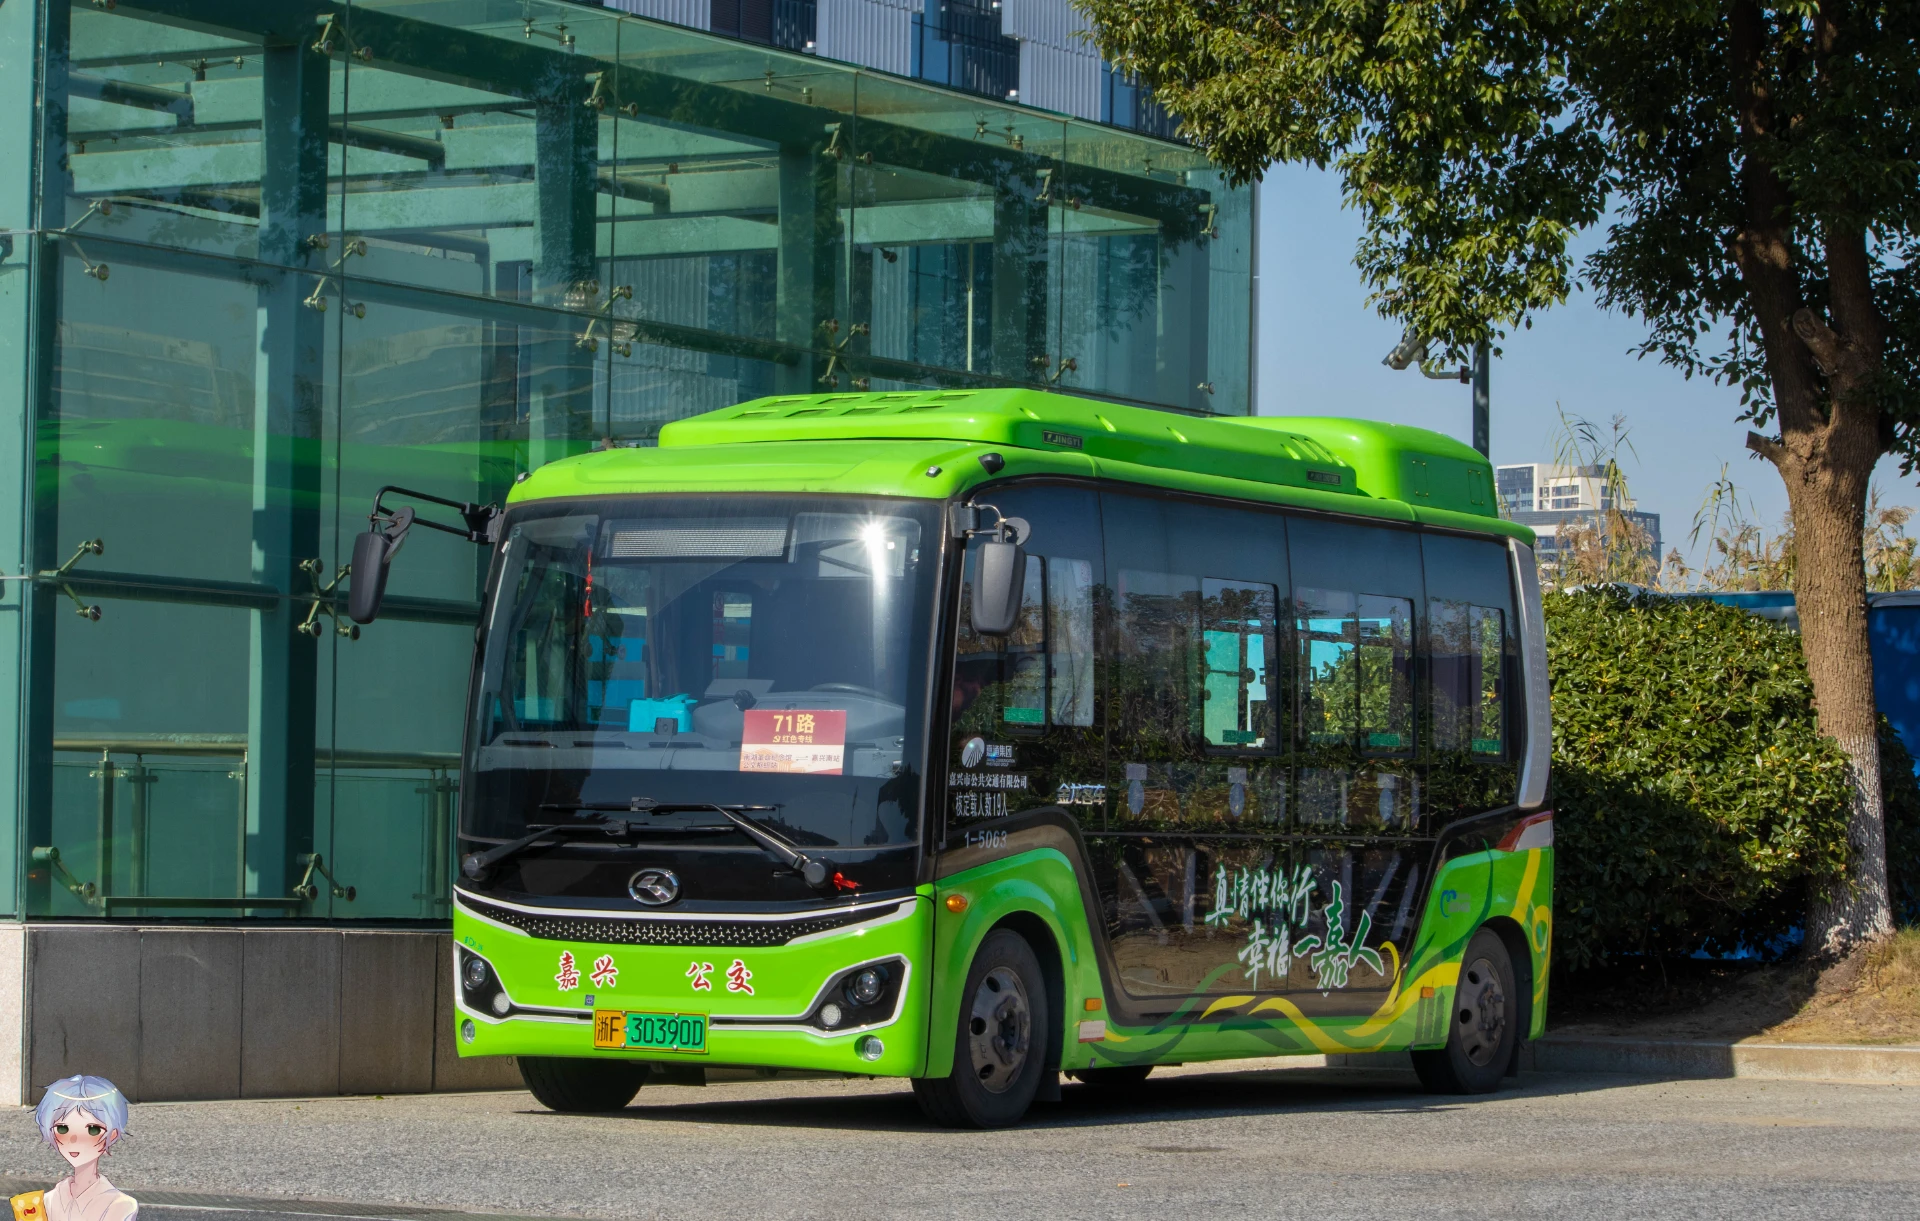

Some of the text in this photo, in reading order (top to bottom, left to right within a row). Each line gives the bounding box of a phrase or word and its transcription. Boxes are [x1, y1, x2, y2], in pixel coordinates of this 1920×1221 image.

[773, 714, 815, 734] 71路
[782, 735, 813, 744] 红色专线
[949, 772, 1028, 789] 嘉兴市公共交通有限公司
[955, 792, 1009, 817] 核定载人数19人
[964, 830, 1008, 849] 1-5063
[1204, 862, 1318, 928] 真情伴你行
